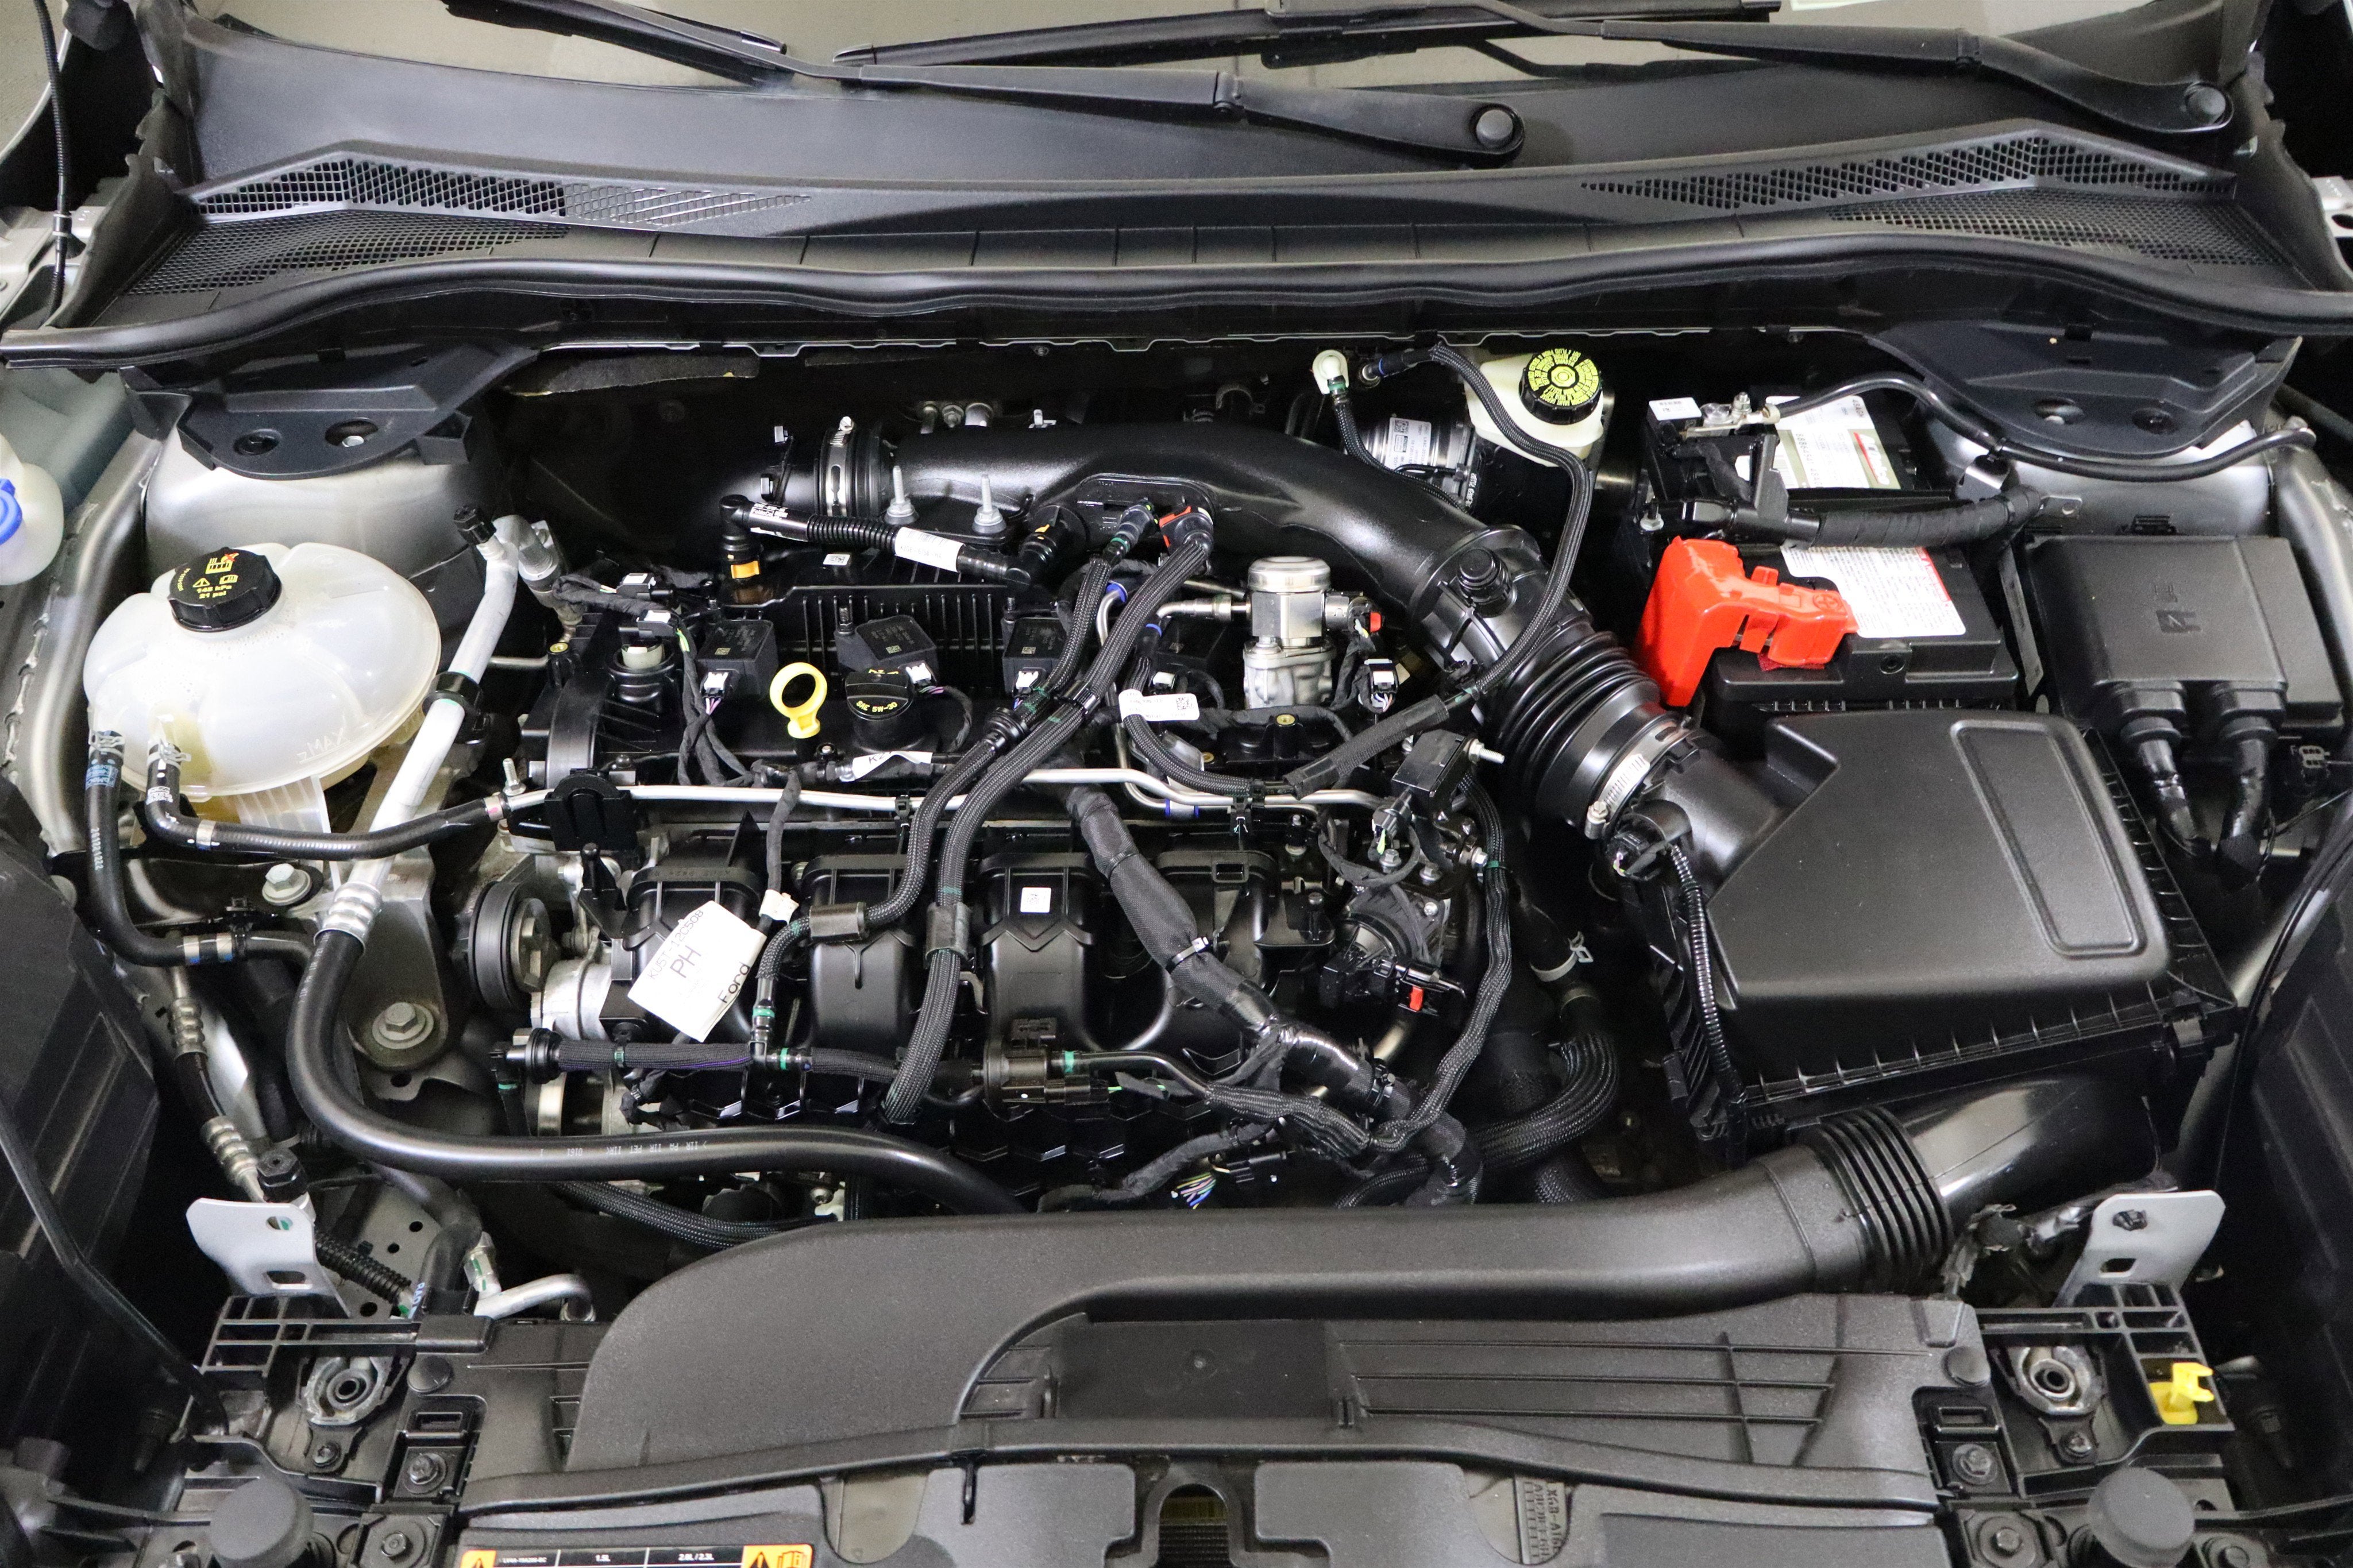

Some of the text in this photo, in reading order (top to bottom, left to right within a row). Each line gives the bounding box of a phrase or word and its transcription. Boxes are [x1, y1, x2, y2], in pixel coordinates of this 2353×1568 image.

[856, 700, 898, 713] SAE 5W-30
[307, 727, 350, 757] MAX
[647, 909, 704, 980] KU5T-12C508
[670, 945, 702, 979] PH
[717, 961, 750, 1004] Ford
